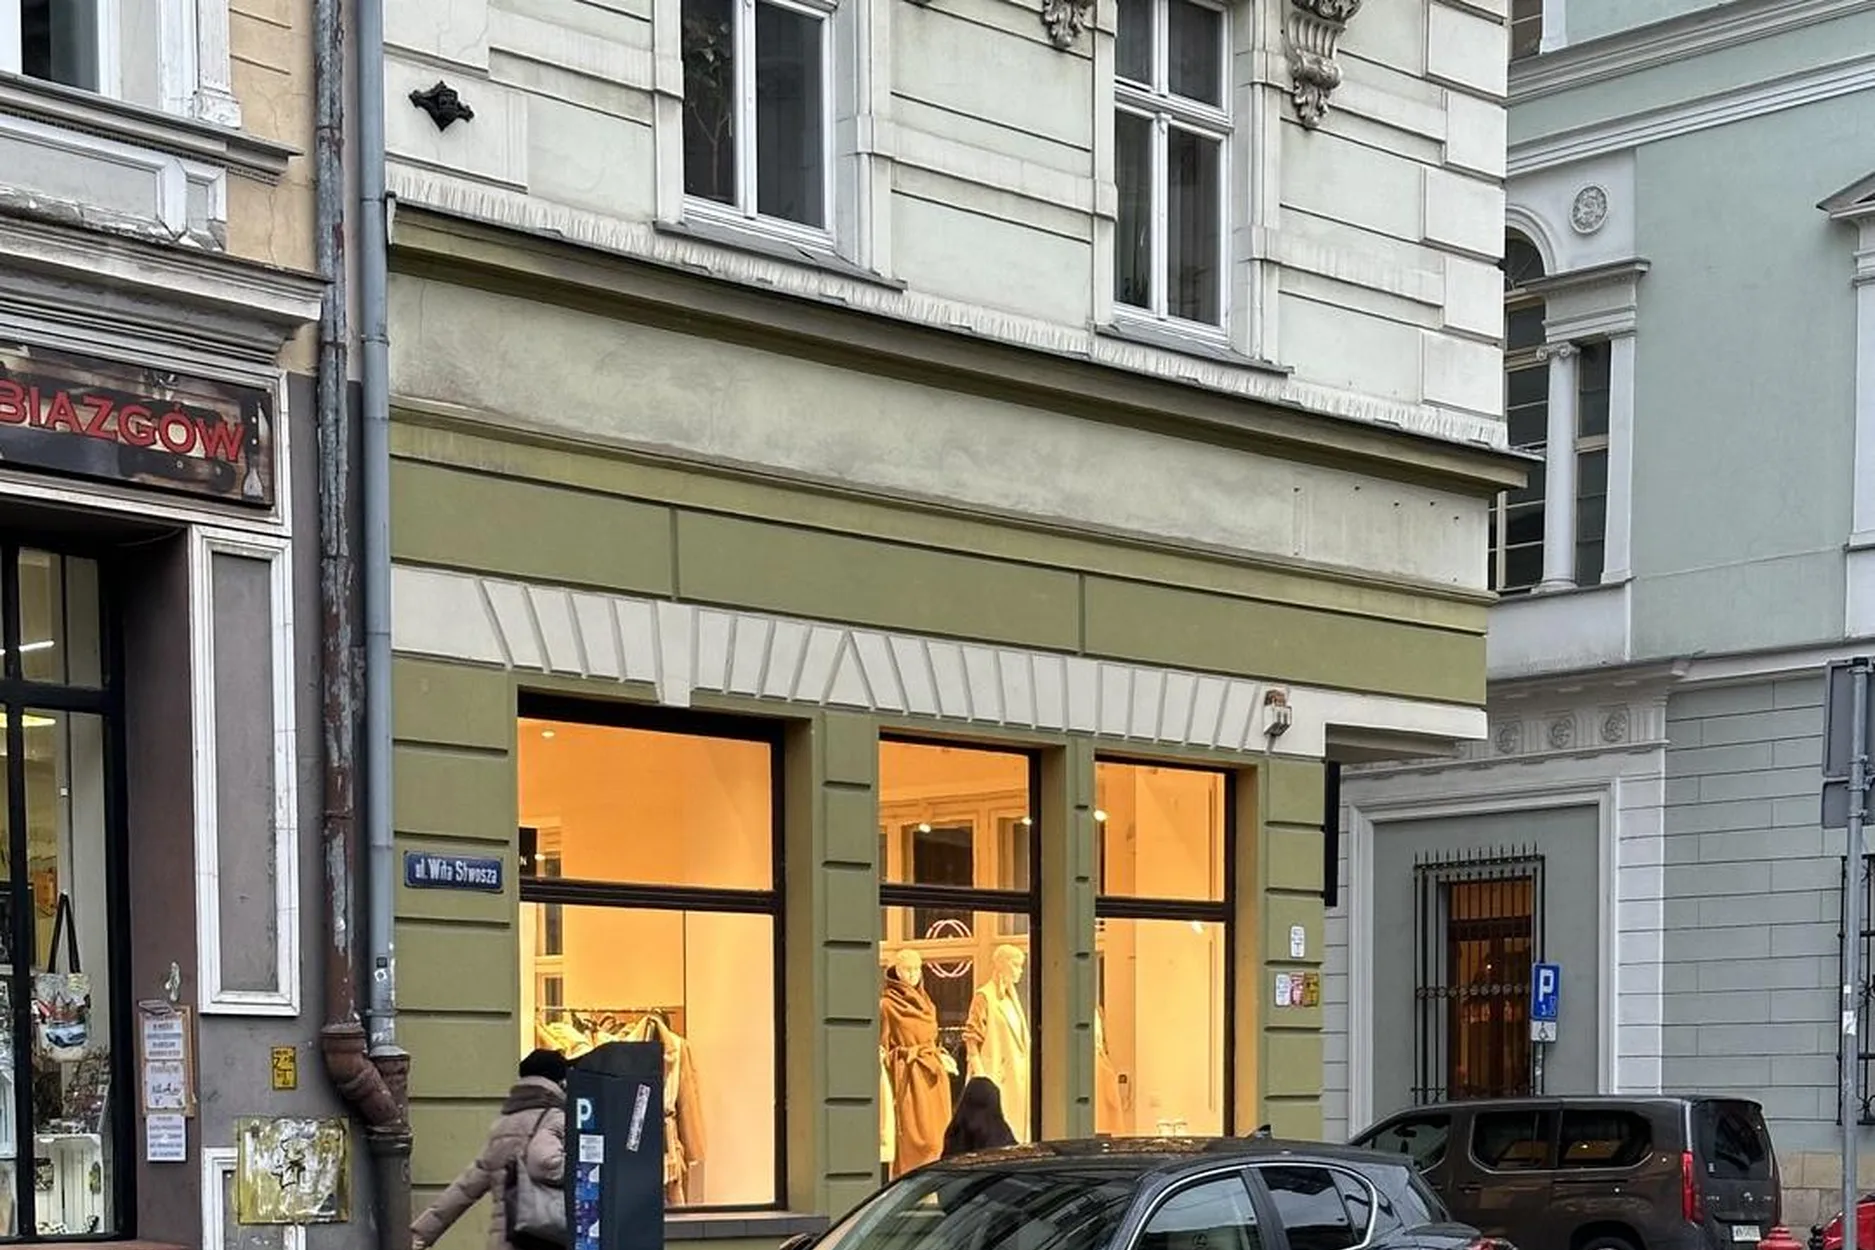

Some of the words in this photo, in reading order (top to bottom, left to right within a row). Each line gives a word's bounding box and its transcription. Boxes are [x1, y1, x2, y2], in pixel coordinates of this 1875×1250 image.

[428, 858, 453, 881] Wita
[456, 860, 497, 884] Stwosza
[576, 1097, 593, 1130] P
